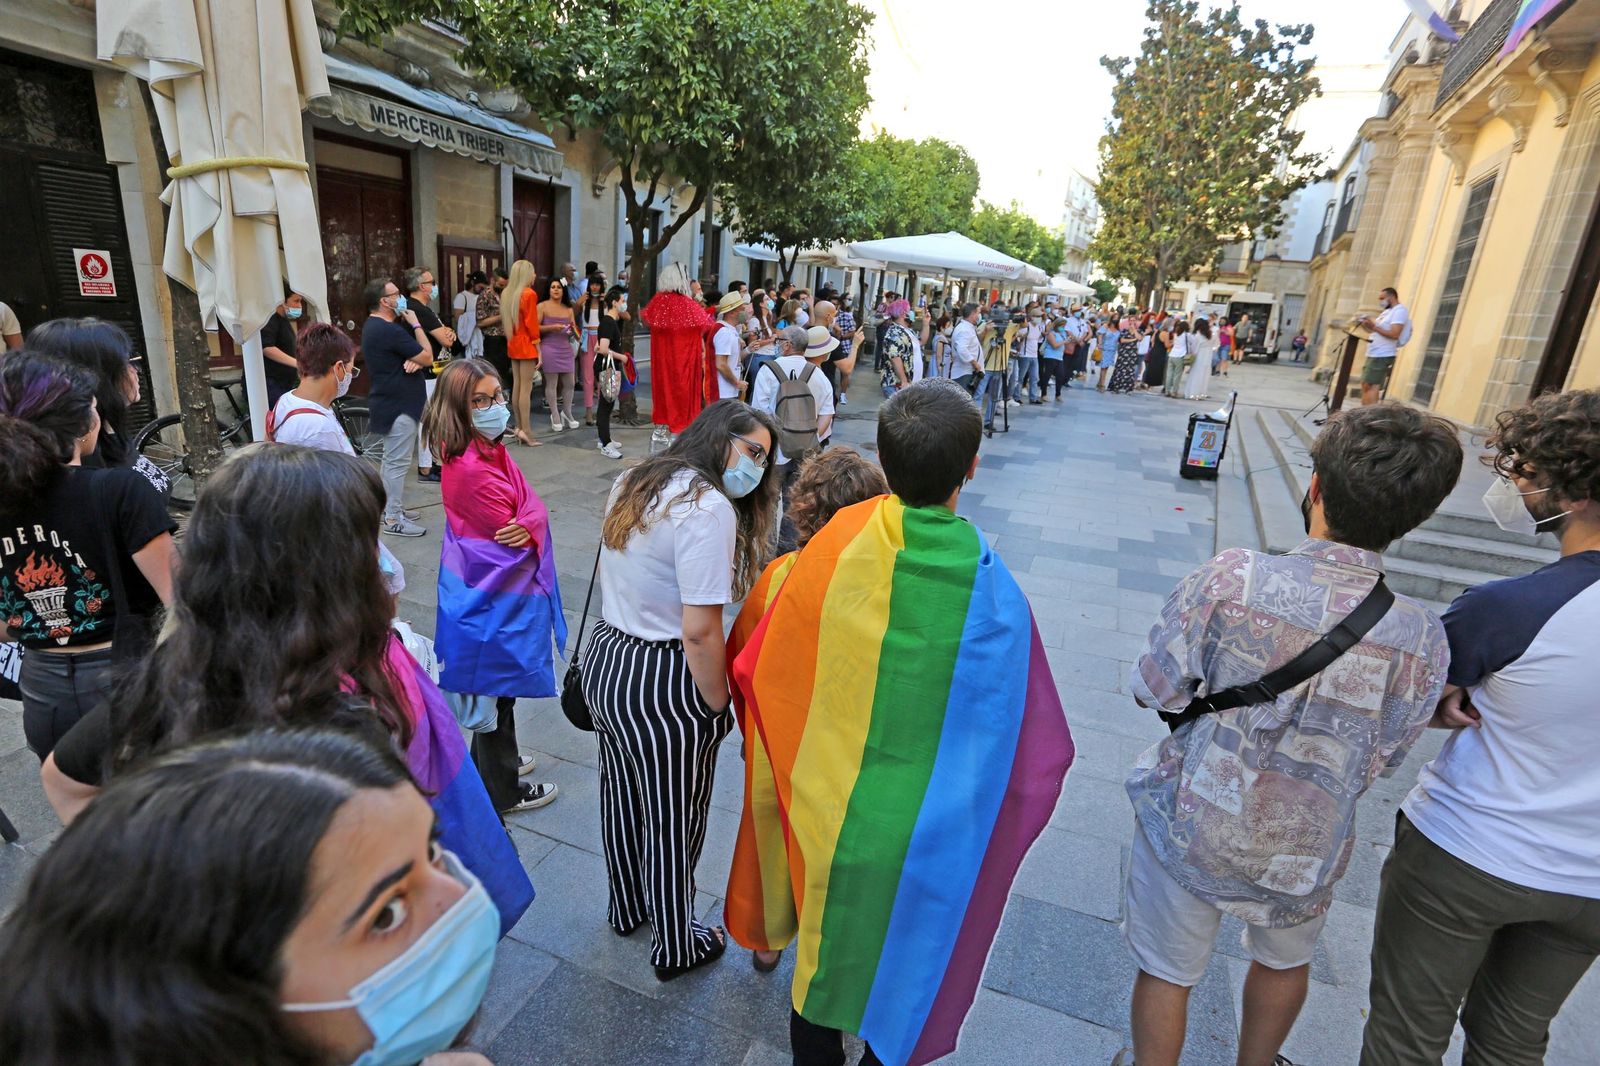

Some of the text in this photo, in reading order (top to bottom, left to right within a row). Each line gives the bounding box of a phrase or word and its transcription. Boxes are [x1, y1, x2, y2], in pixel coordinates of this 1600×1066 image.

[369, 103, 506, 157] MERCERIA TRIBER
[0, 525, 87, 569] DEROSA
